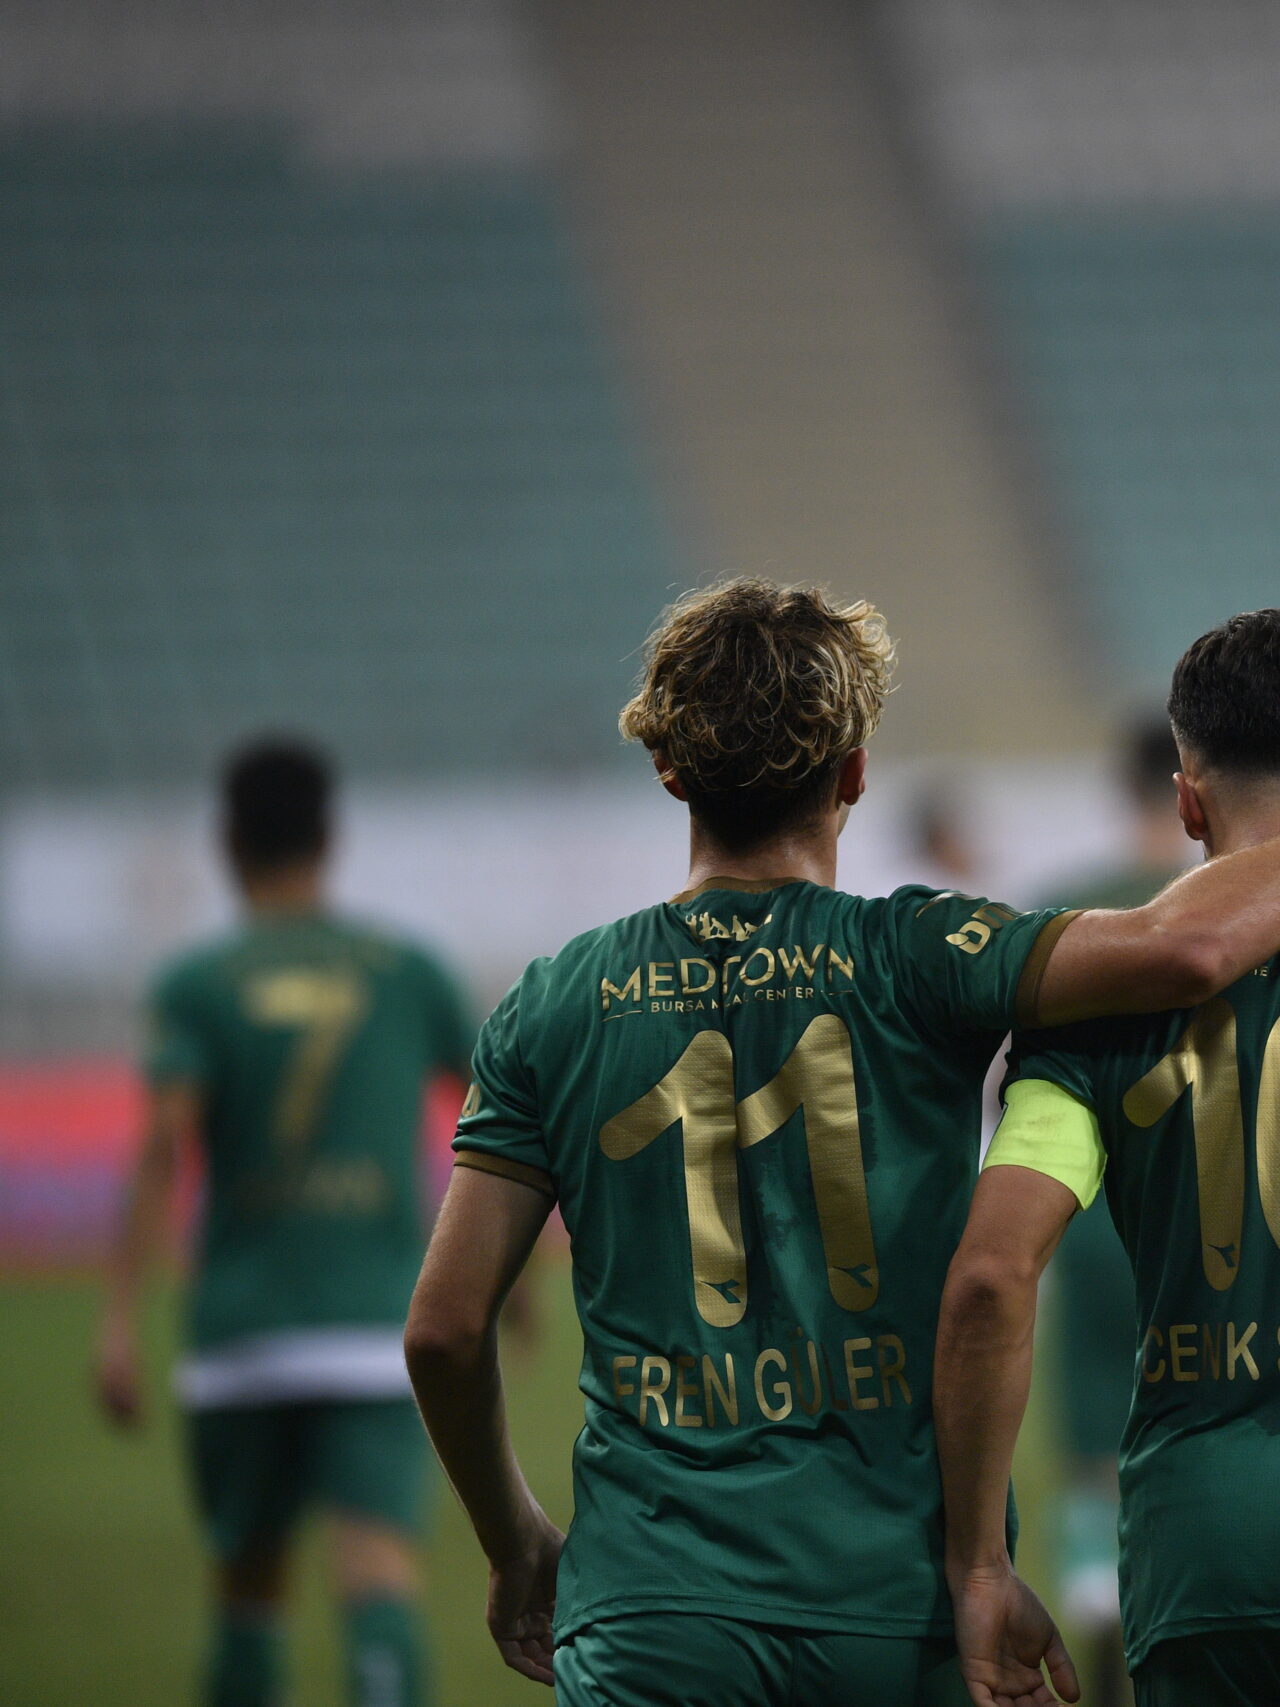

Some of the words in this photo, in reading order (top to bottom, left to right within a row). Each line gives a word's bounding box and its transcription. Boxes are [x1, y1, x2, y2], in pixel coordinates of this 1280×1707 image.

[244, 968, 372, 1146] 7
[651, 999, 705, 1014] BURSA
[599, 1014, 880, 1328] 11
[1142, 1321, 1260, 1384] CENK
